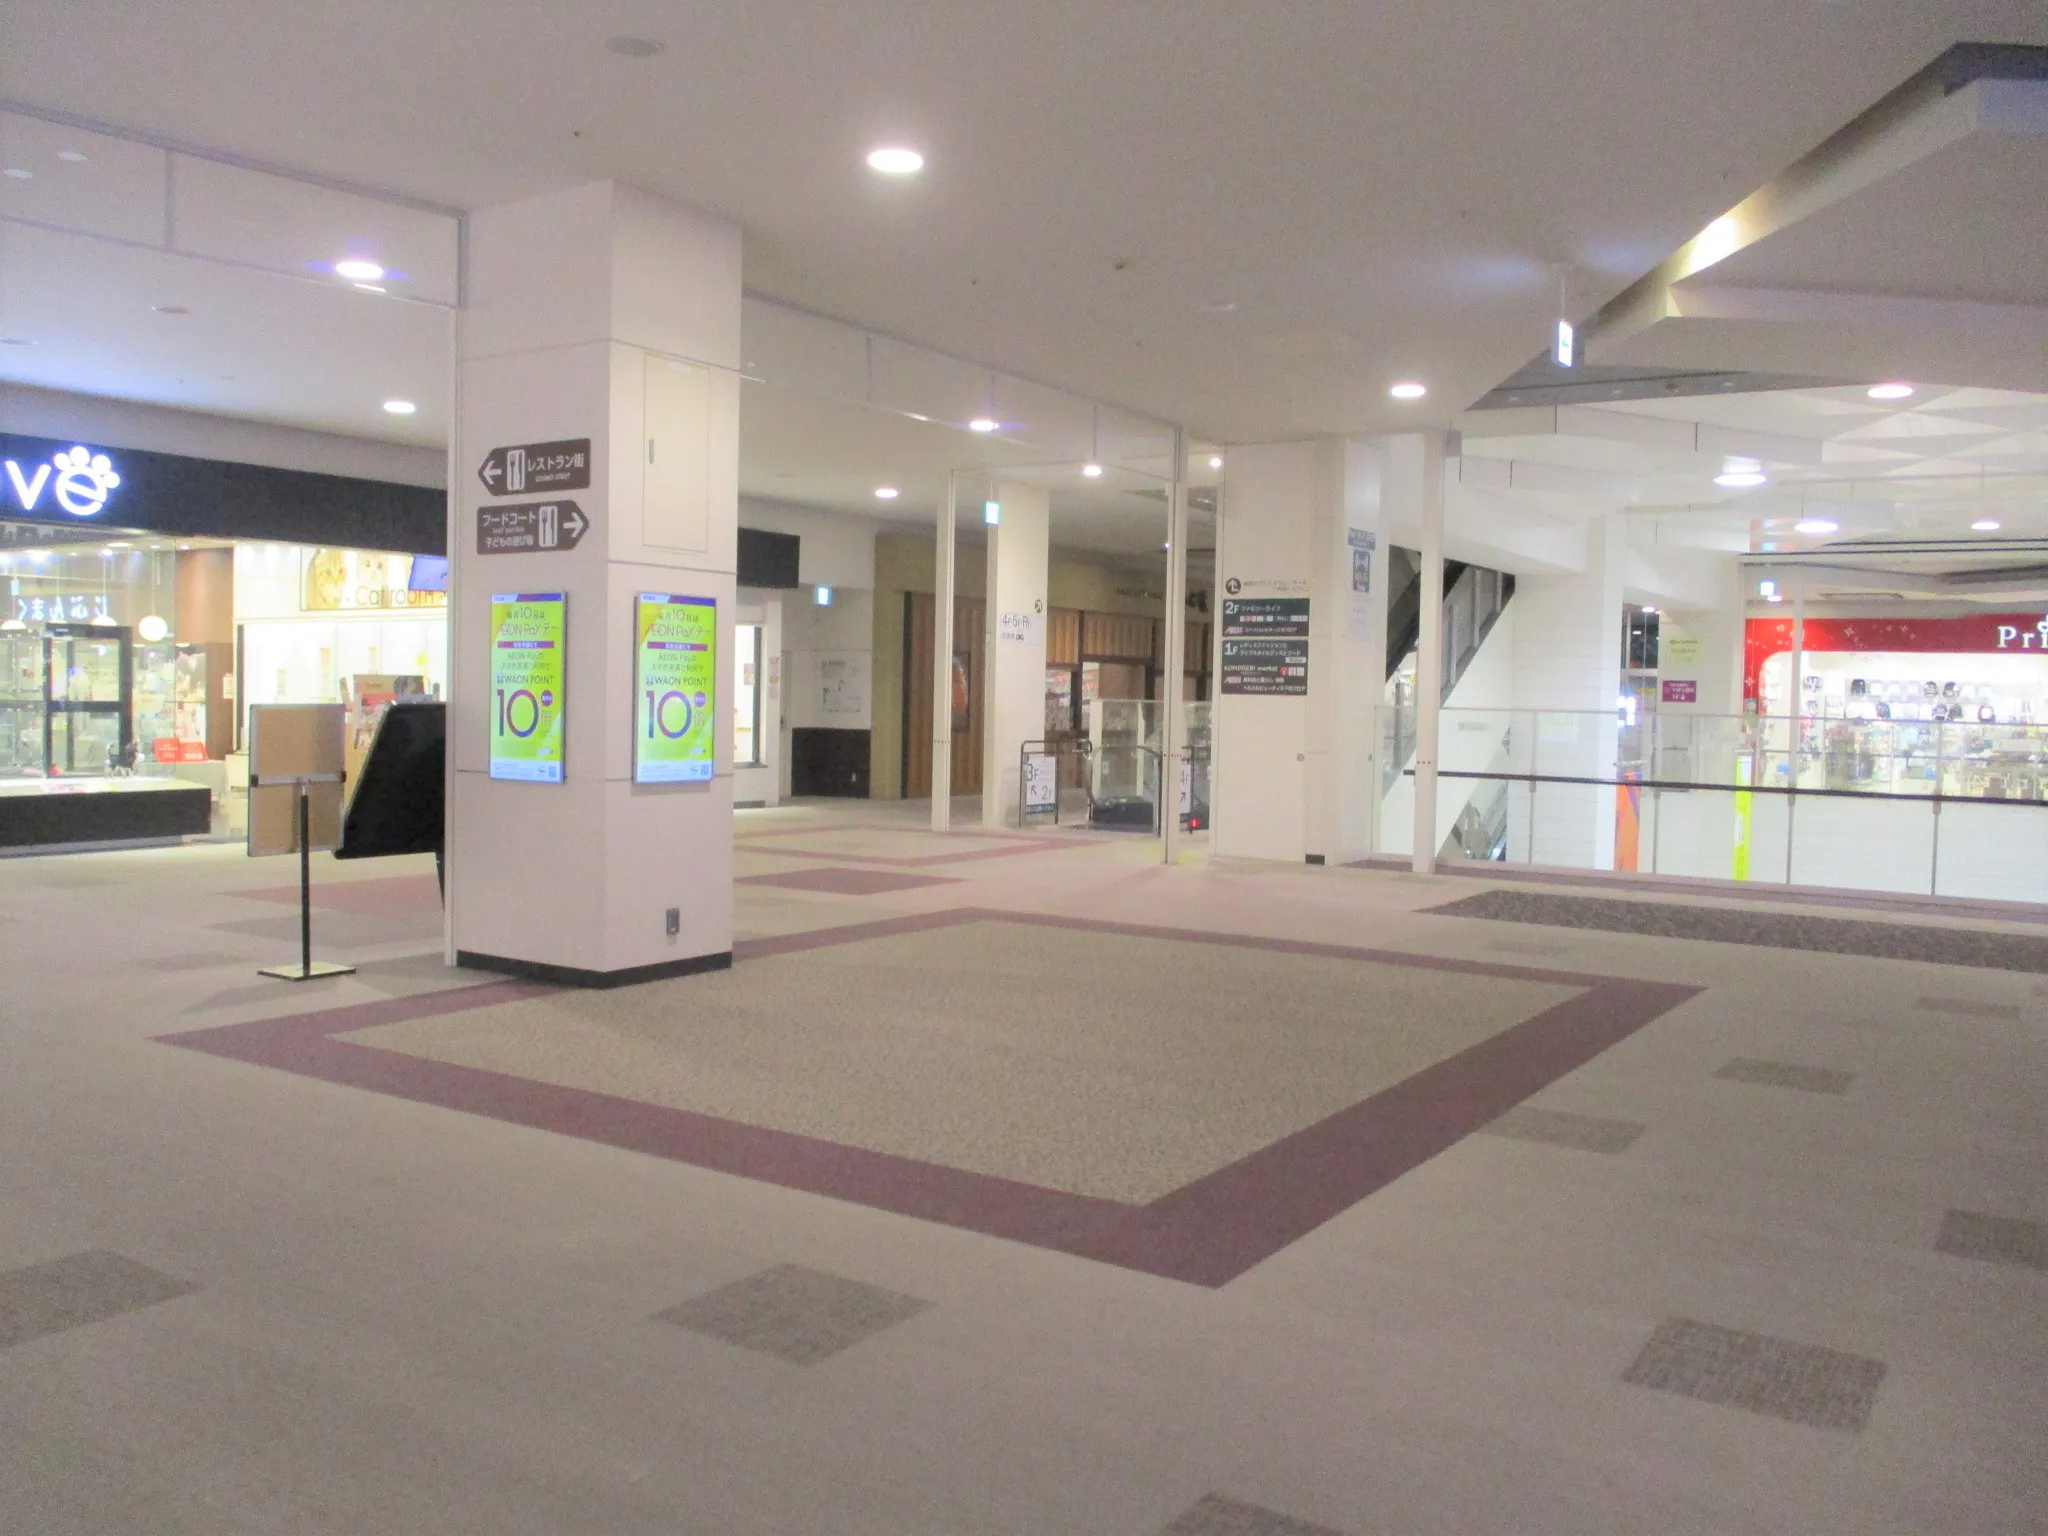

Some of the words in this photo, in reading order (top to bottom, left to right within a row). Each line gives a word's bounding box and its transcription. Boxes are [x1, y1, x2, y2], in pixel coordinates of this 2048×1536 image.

[527, 453, 584, 471] レストラン街
[483, 510, 537, 527] フードコート
[356, 585, 386, 605] Cat
[1225, 602, 1240, 614] 2F
[1224, 642, 1238, 655] 1F
[505, 675, 529, 684] WAON
[530, 675, 554, 684] POINT
[654, 676, 681, 685] WAON
[683, 677, 708, 686] POINT
[1042, 785, 1053, 800] 2F
